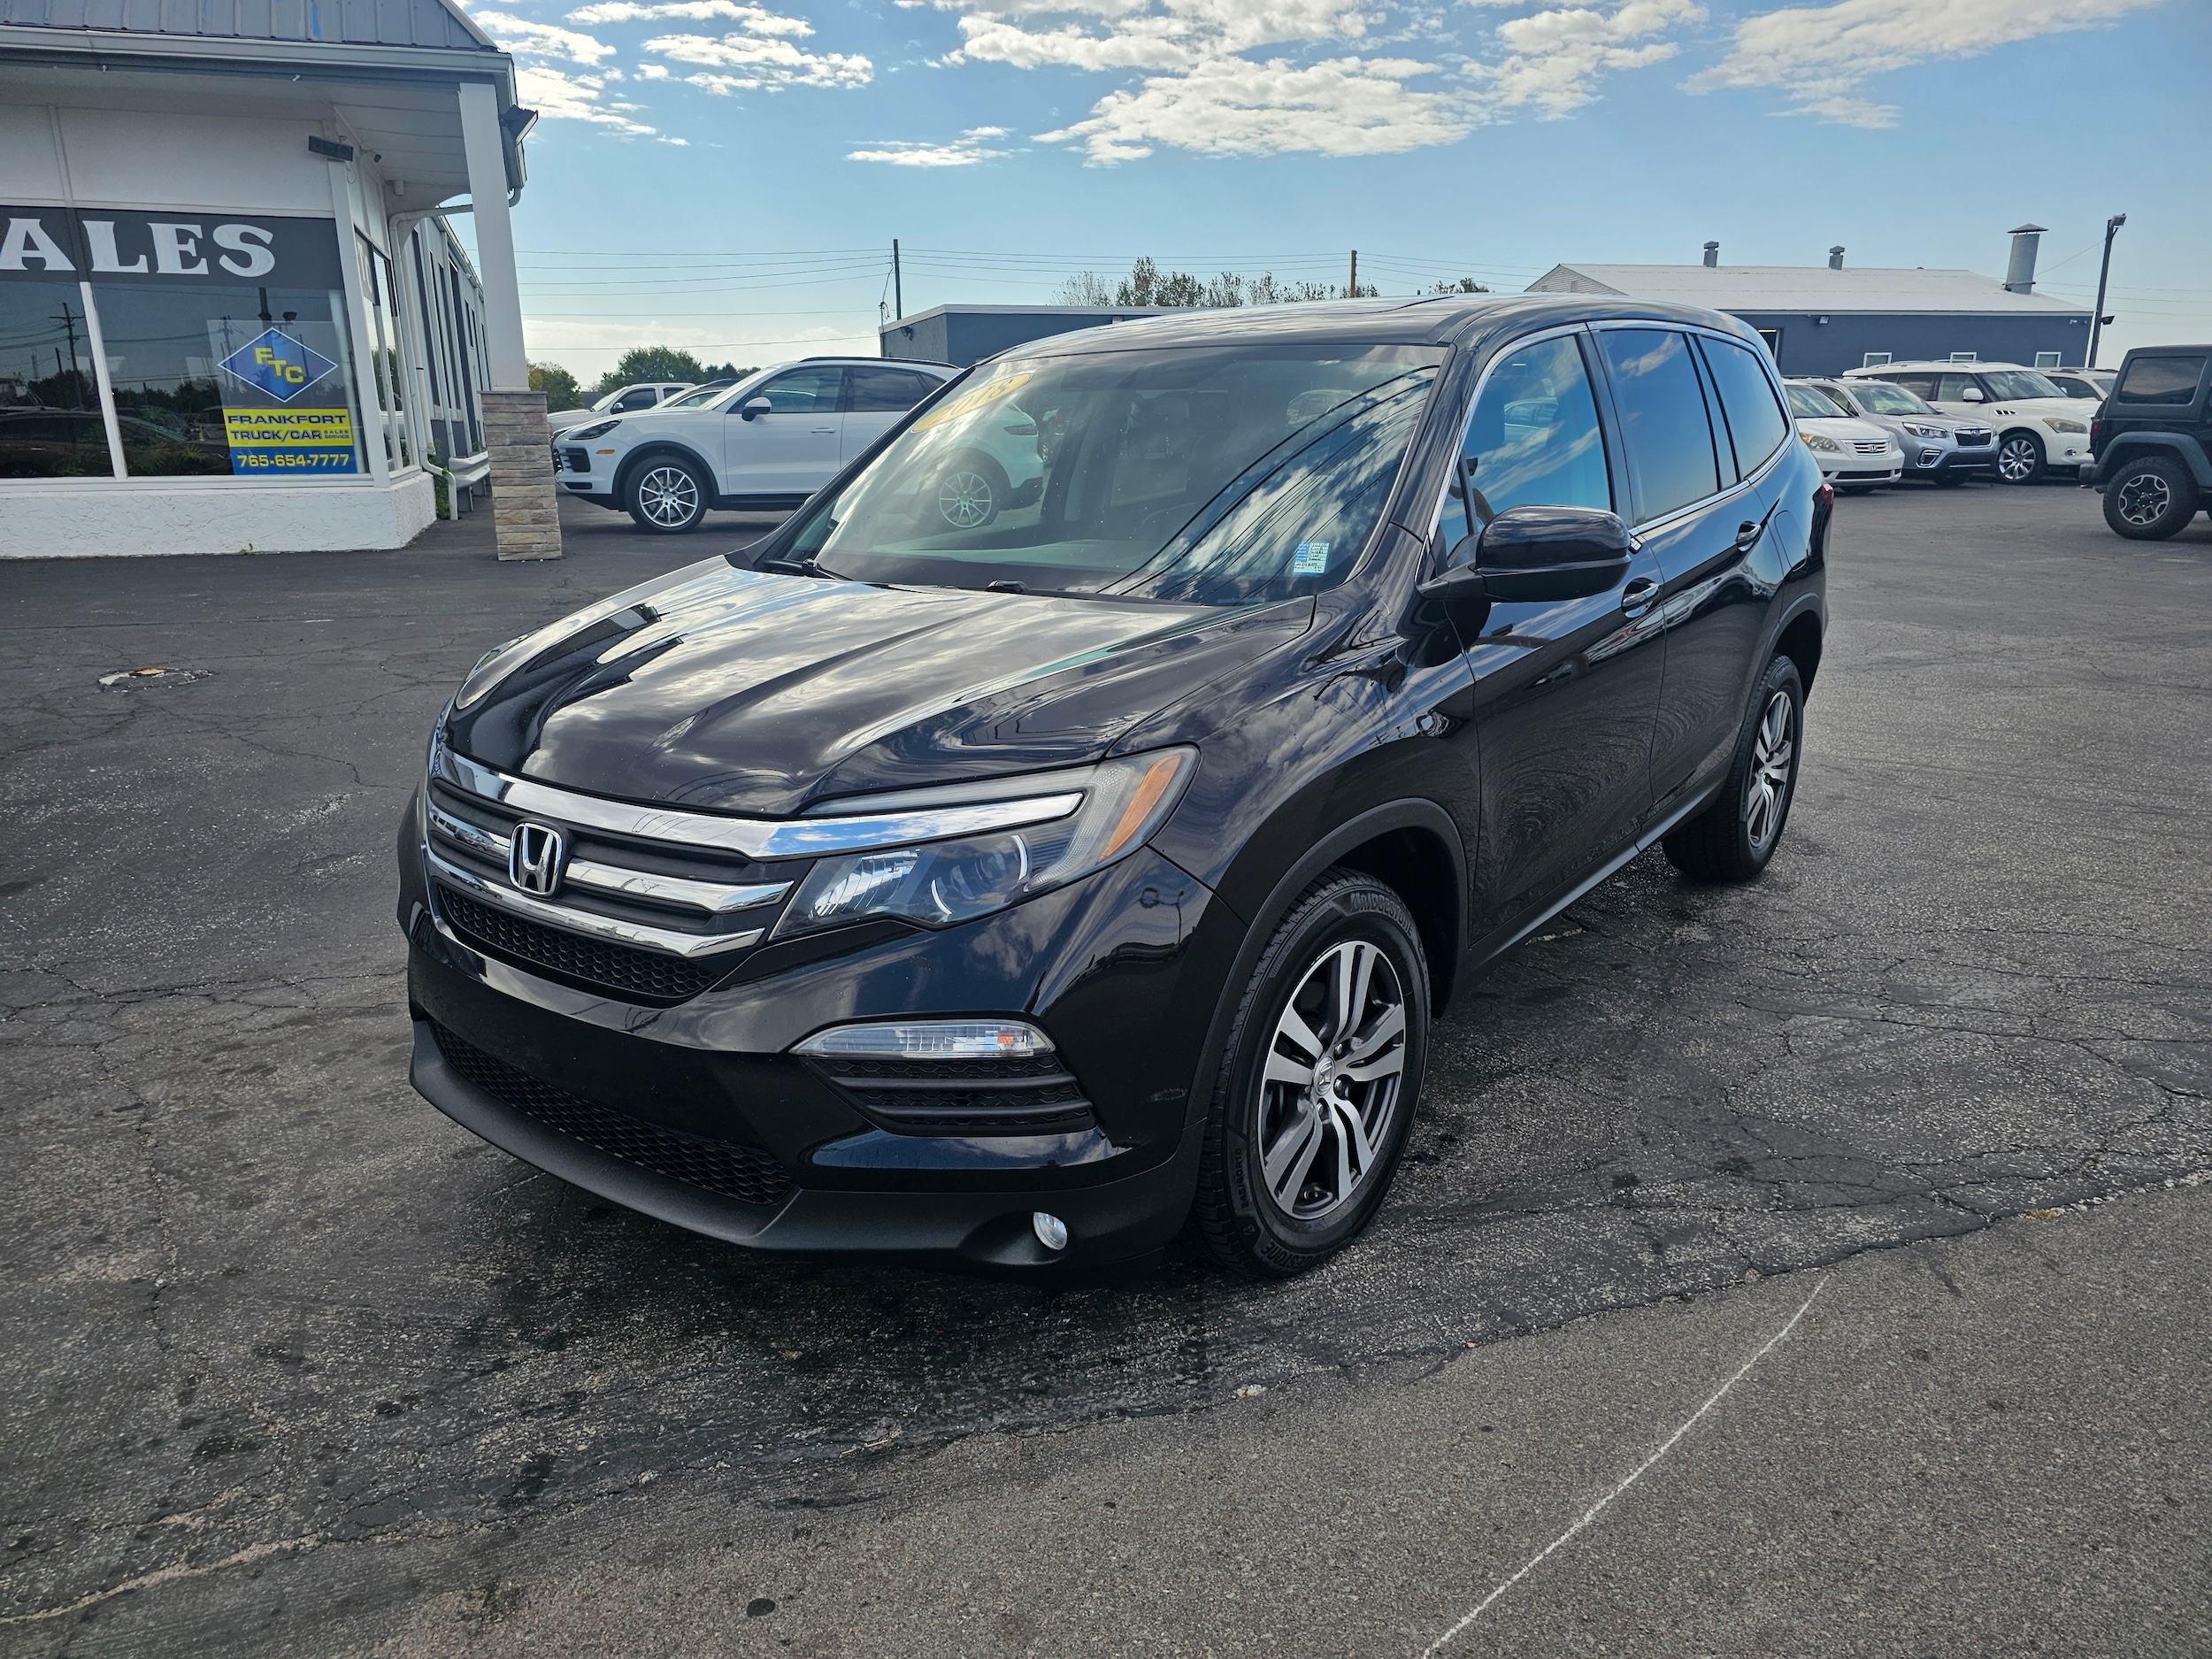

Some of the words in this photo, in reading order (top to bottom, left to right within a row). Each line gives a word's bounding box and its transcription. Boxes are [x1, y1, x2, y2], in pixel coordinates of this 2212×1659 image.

[254, 347, 304, 384] FTC
[227, 415, 347, 425] FRANKFORT
[230, 429, 323, 442] TRUCK/CAR
[236, 453, 350, 468] 765-654-7777
[1349, 892, 1413, 938] BRIDGESTONE
